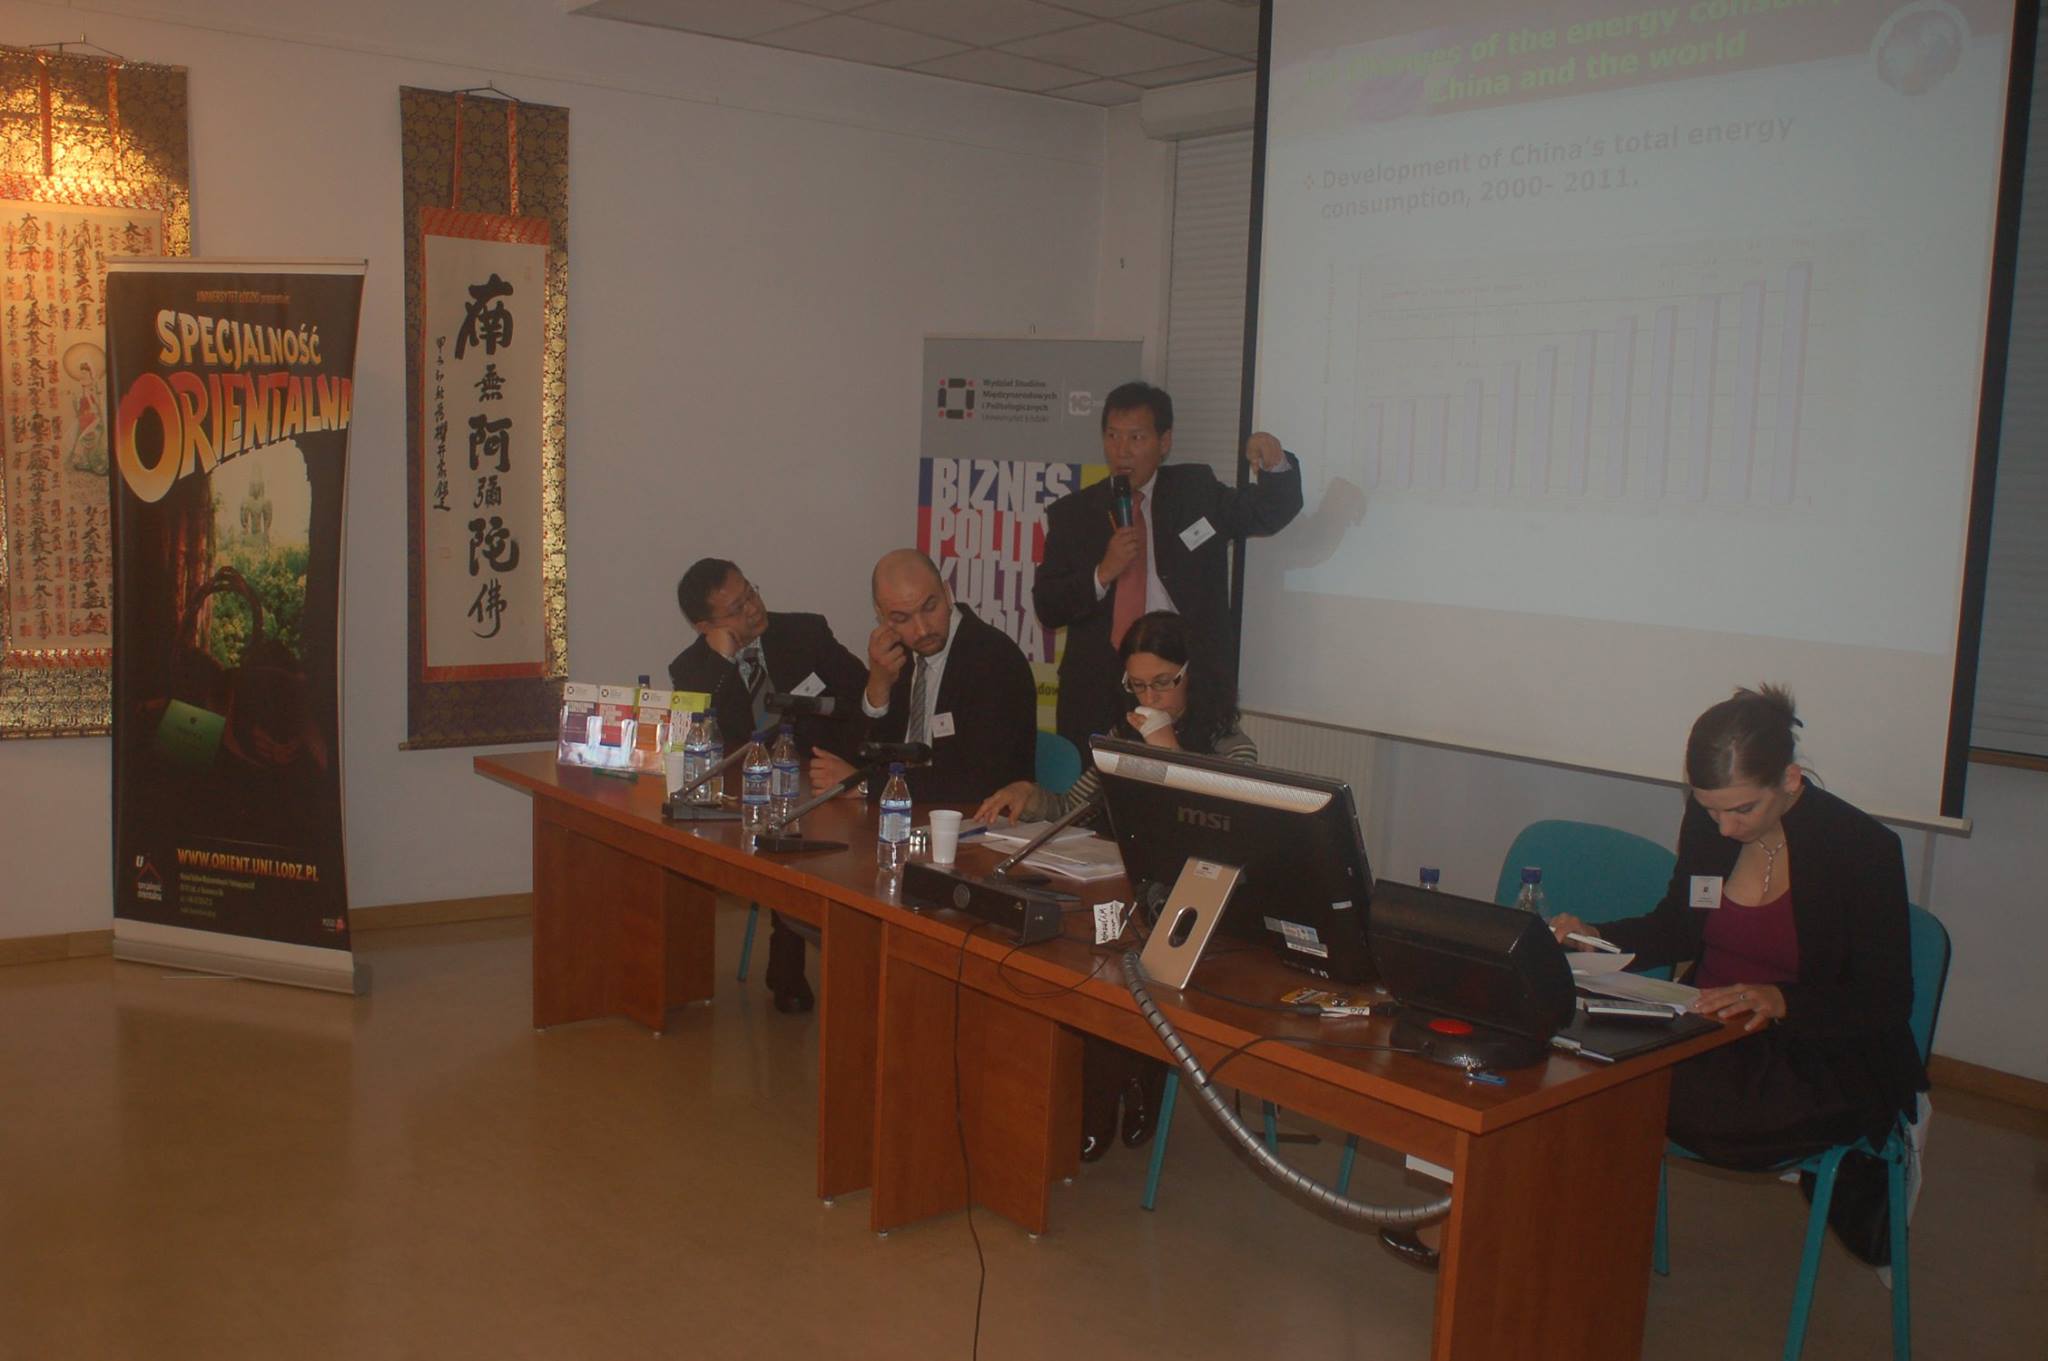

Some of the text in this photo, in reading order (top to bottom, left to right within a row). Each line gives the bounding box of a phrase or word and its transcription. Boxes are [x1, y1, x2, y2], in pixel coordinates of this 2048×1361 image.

[1471, 31, 1504, 62] of
[1507, 23, 1557, 53] the
[1566, 7, 1679, 43] energy
[1427, 30, 1747, 103] China and the world
[1322, 115, 1794, 190] Development of China's total energy
[1321, 166, 1640, 220] consumption, 2000- 2011.
[155, 309, 322, 370] SPECJALNOŚĆ
[931, 457, 1073, 512] BIZNES
[1177, 804, 1232, 833] msi
